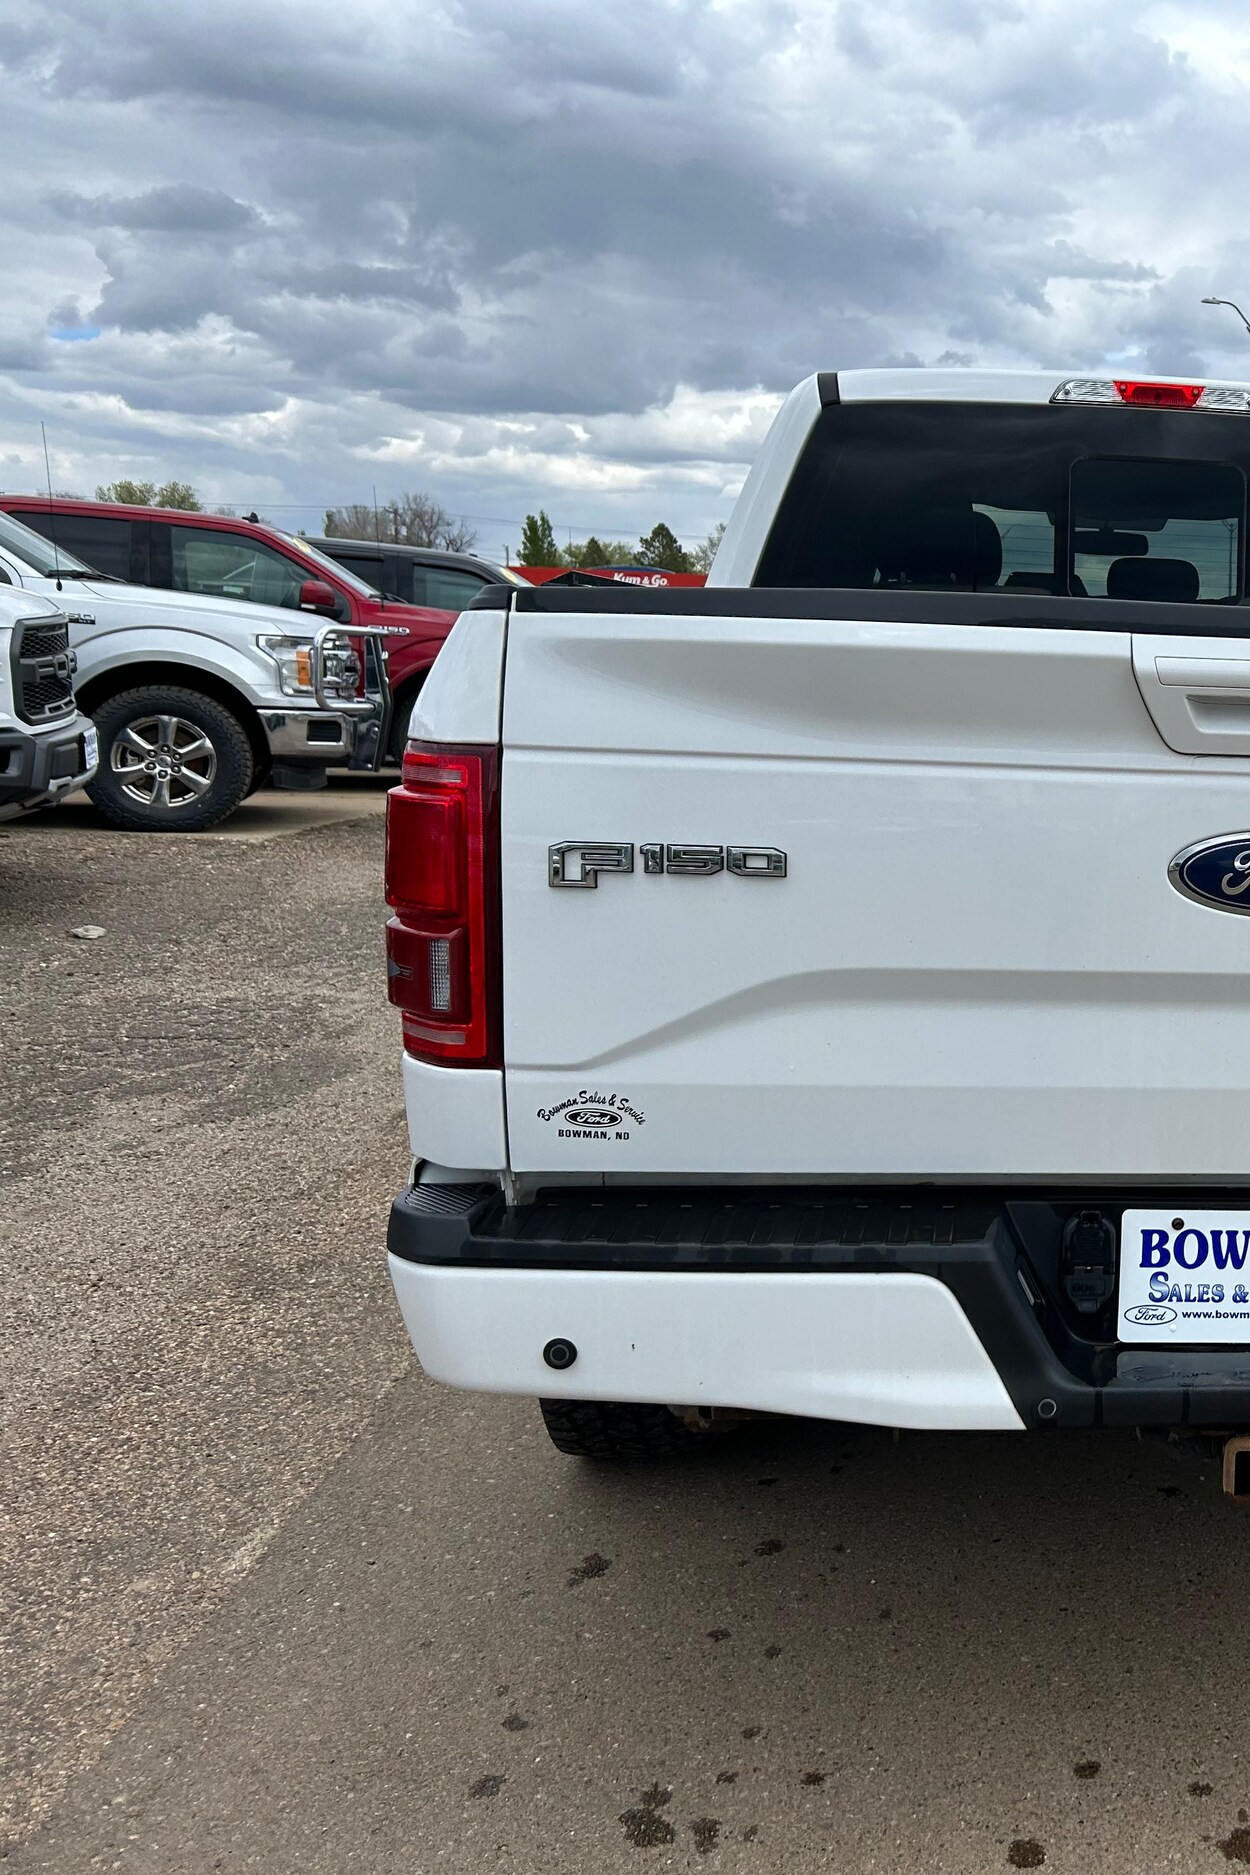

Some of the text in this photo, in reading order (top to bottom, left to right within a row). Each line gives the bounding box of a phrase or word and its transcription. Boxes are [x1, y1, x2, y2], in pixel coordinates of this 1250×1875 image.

[613, 572, 640, 585] Kum
[651, 574, 668, 588] Go
[537, 1090, 646, 1125] Bowman Sales & Service
[576, 1111, 611, 1123] Ford
[558, 1129, 630, 1140] BOWMAN, ND
[1232, 1284, 1249, 1304] &
[1134, 1308, 1168, 1322] Ford
